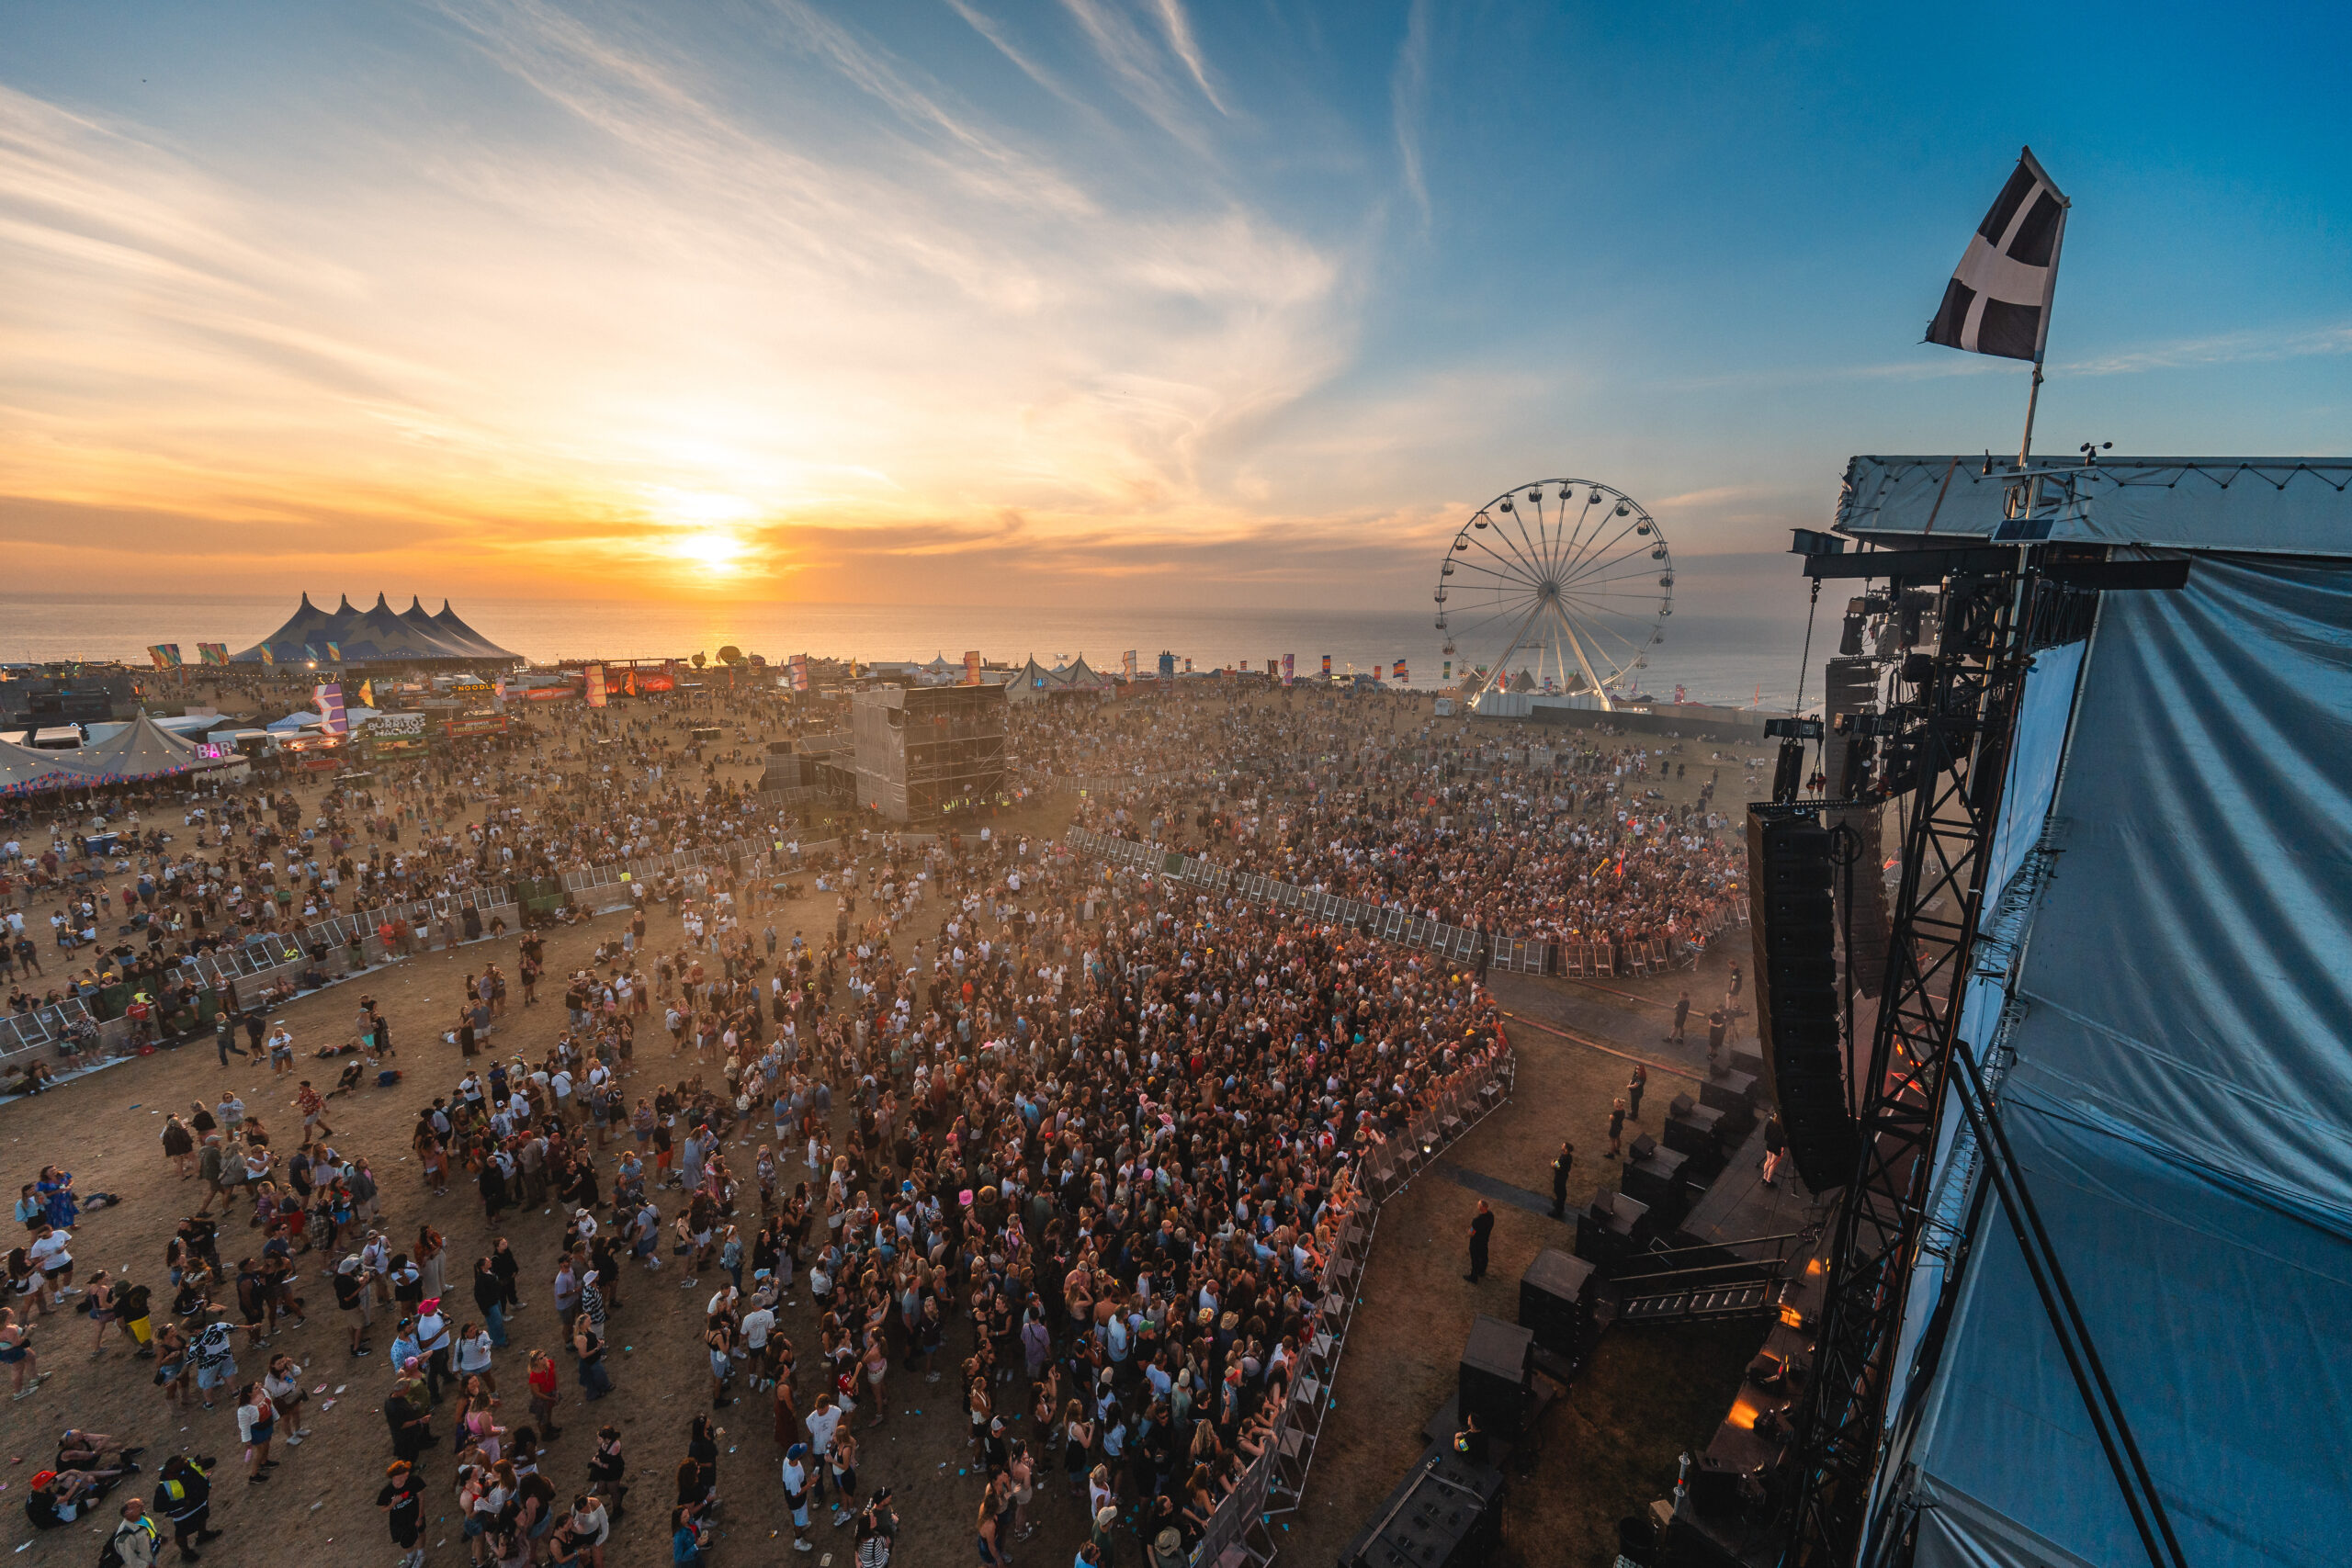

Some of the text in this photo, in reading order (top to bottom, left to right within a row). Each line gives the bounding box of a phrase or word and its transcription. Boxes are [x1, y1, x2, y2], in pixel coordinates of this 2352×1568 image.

[368, 716, 426, 730] BURRITOS
[375, 726, 422, 736] NACHOS
[197, 742, 232, 759] BAR
